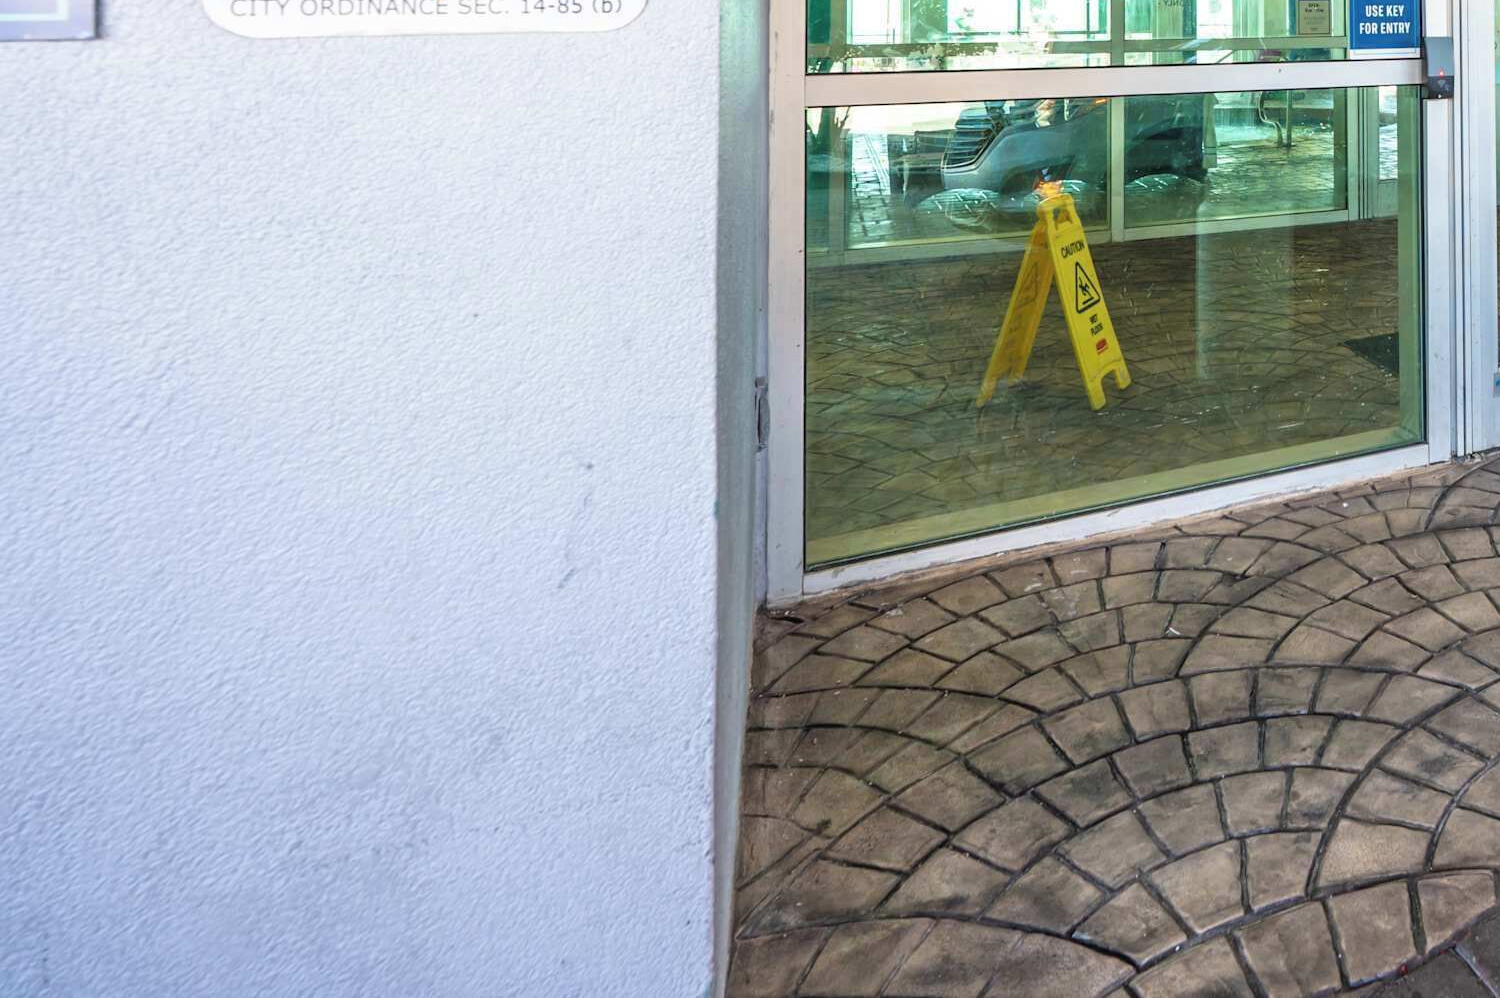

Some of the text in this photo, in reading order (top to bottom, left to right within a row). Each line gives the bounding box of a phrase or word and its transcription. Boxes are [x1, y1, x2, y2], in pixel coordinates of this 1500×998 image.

[1365, 4, 1405, 17] USE KEY
[1359, 22, 1411, 35] FOR ENTRY
[1061, 240, 1085, 258] CAUTION
